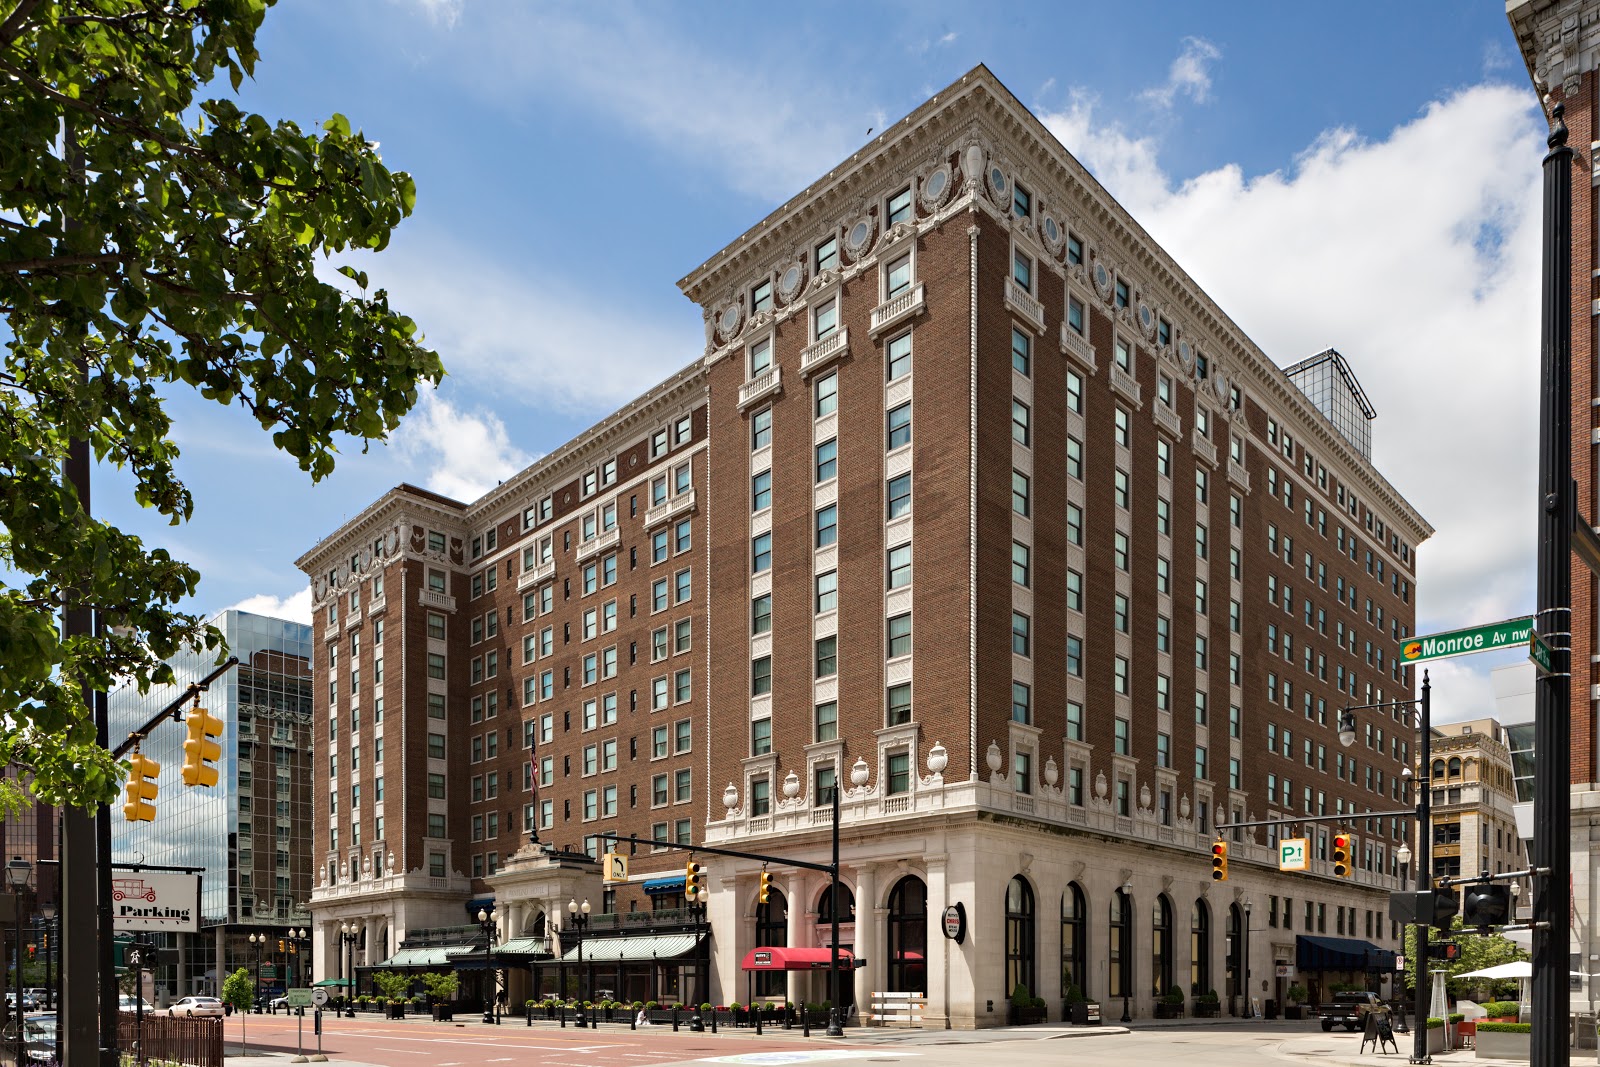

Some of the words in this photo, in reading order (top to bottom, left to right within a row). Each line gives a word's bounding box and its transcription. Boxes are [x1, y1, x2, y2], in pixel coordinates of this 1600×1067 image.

[1423, 634, 1484, 656] Monroe
[1492, 631, 1507, 645] Av
[1512, 628, 1529, 641] nw
[121, 905, 190, 923] Parking
